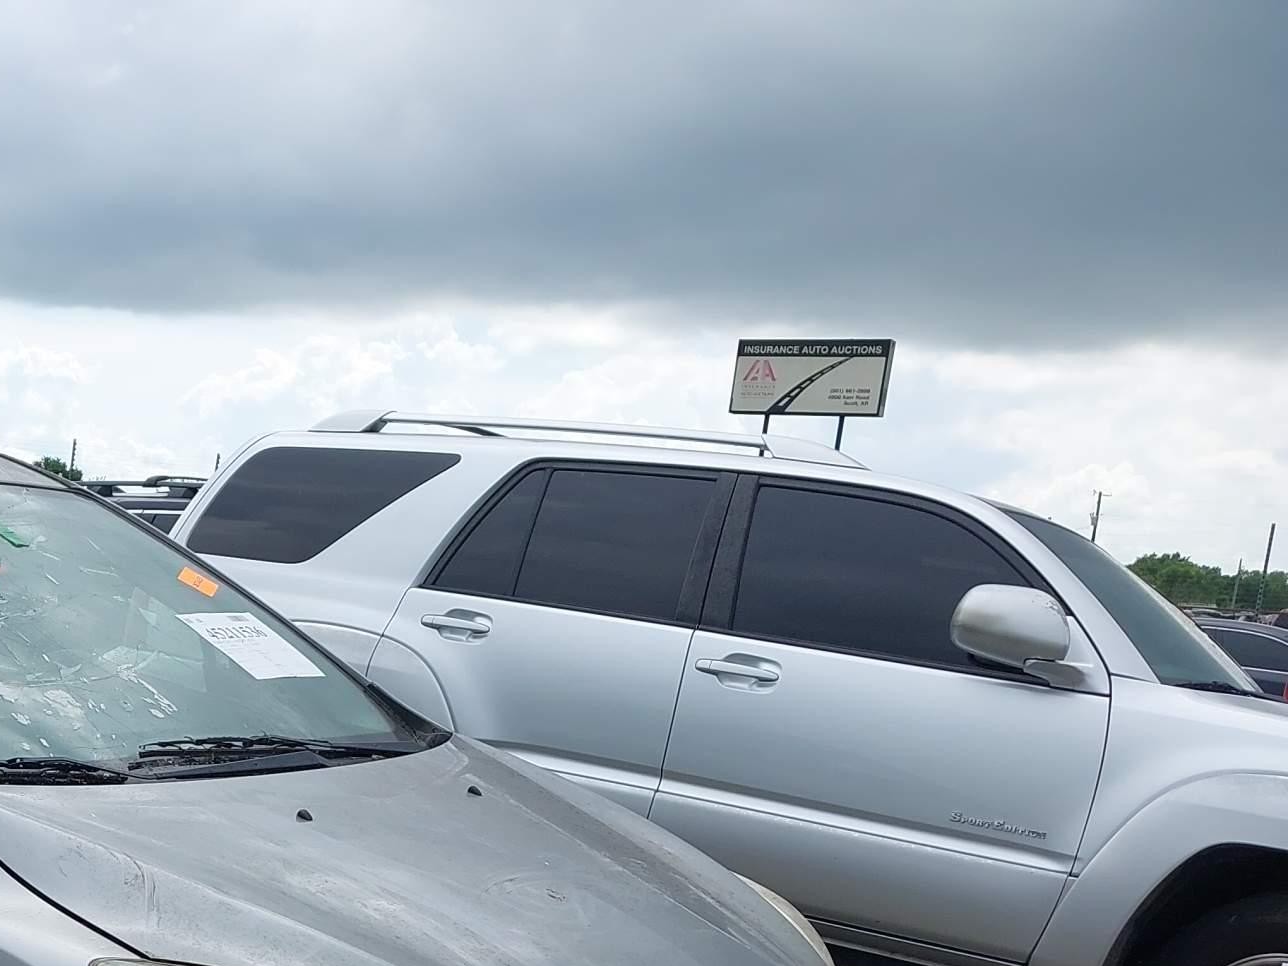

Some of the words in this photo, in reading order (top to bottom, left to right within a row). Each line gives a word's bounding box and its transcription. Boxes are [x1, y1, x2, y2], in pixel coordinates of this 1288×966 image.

[743, 345, 800, 354] INSURANCE
[801, 345, 829, 354] AUTO
[831, 345, 883, 354] AUCTIONS
[205, 625, 268, 640] 45211536
